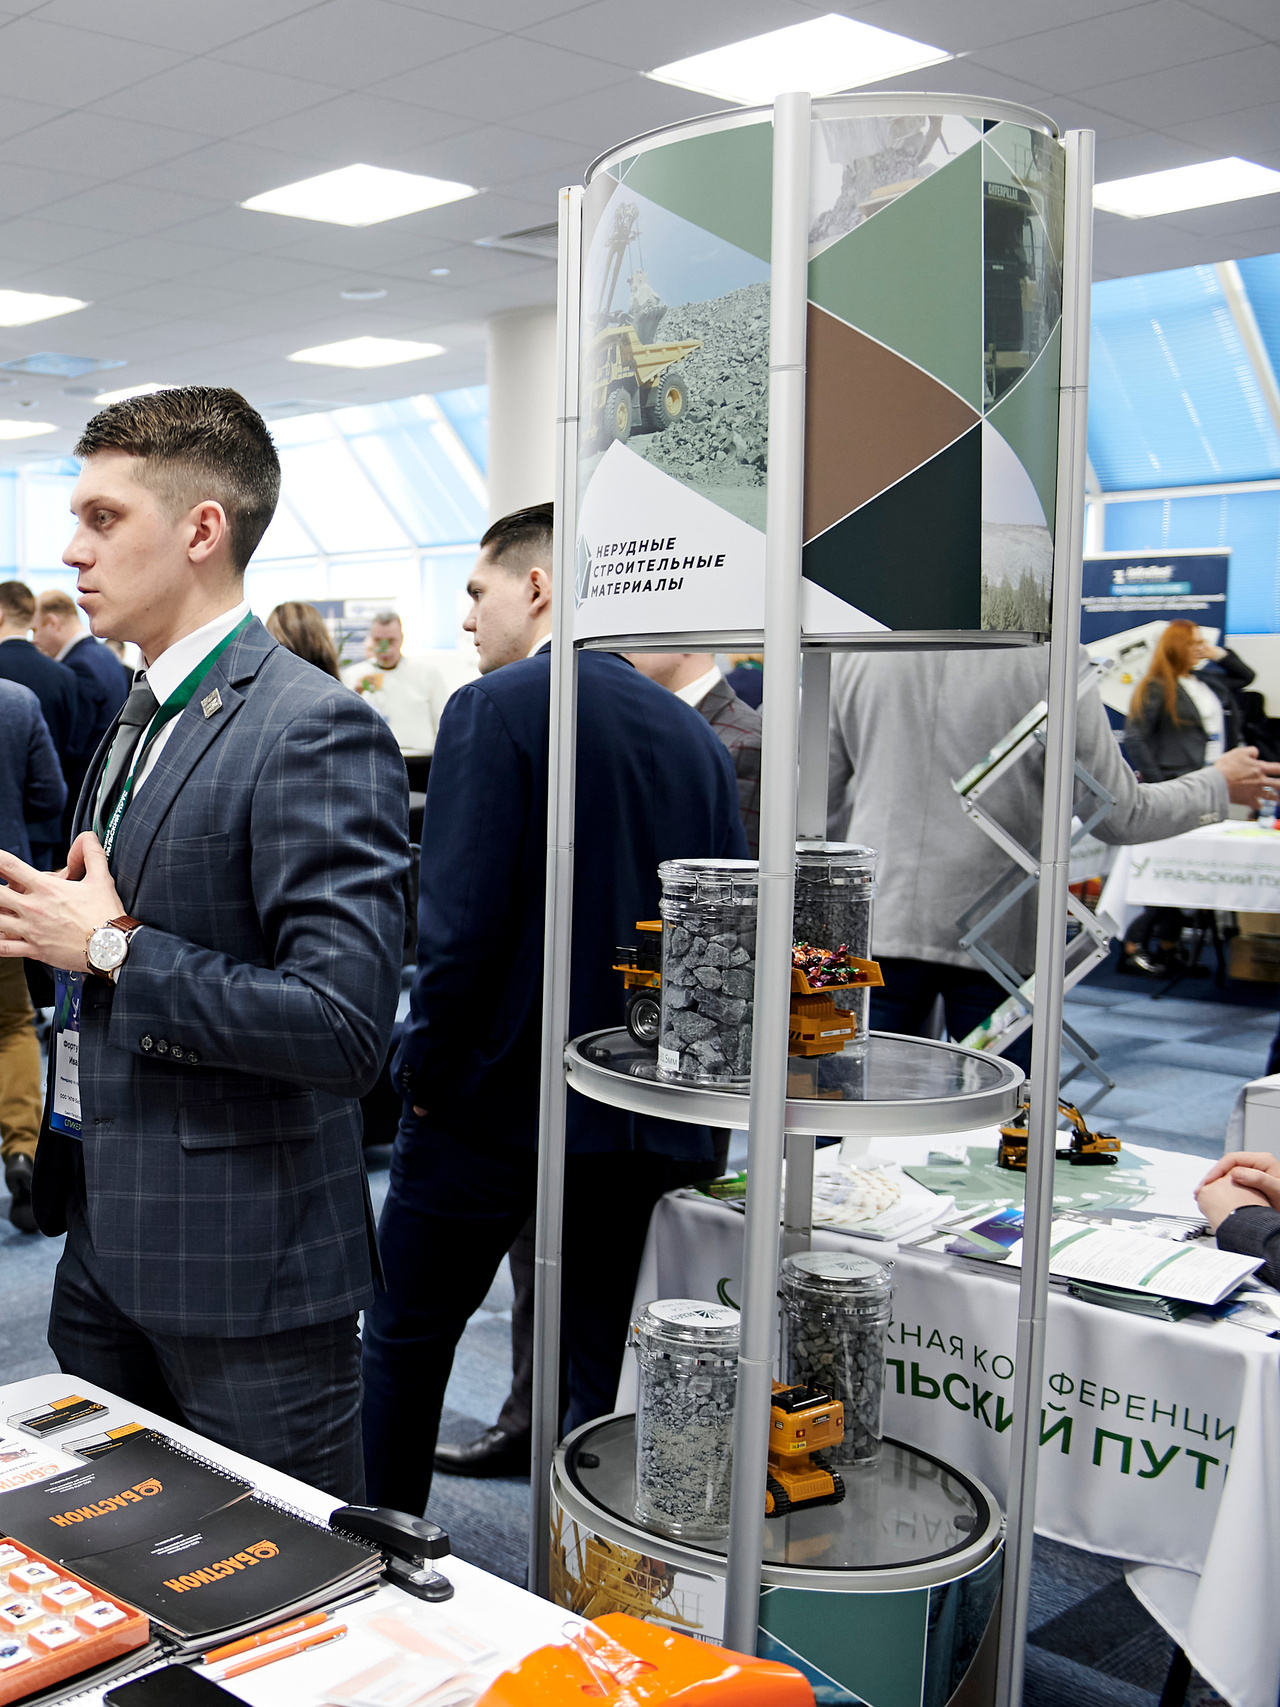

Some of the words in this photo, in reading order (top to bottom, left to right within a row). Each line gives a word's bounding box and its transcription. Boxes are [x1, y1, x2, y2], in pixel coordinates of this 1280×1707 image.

[596, 537, 677, 559] НЕРУДНЫЕ
[593, 554, 727, 578] СТРОИТЕЛЬНЫЕ
[590, 577, 685, 598] МАТЕРИАЛЫ
[1258, 874, 1280, 887] ПУ
[64, 1040, 79, 1053] Форту
[69, 1056, 79, 1066] Ива
[973, 1345, 1236, 1449] КОФЕРЕНЦИ
[883, 1358, 1073, 1455] ЛЬСКИЙ
[1092, 1427, 1229, 1490] ПУТ
[49, 1489, 143, 1528] БАСТИОН
[163, 1550, 258, 1593] БАСТИОН
